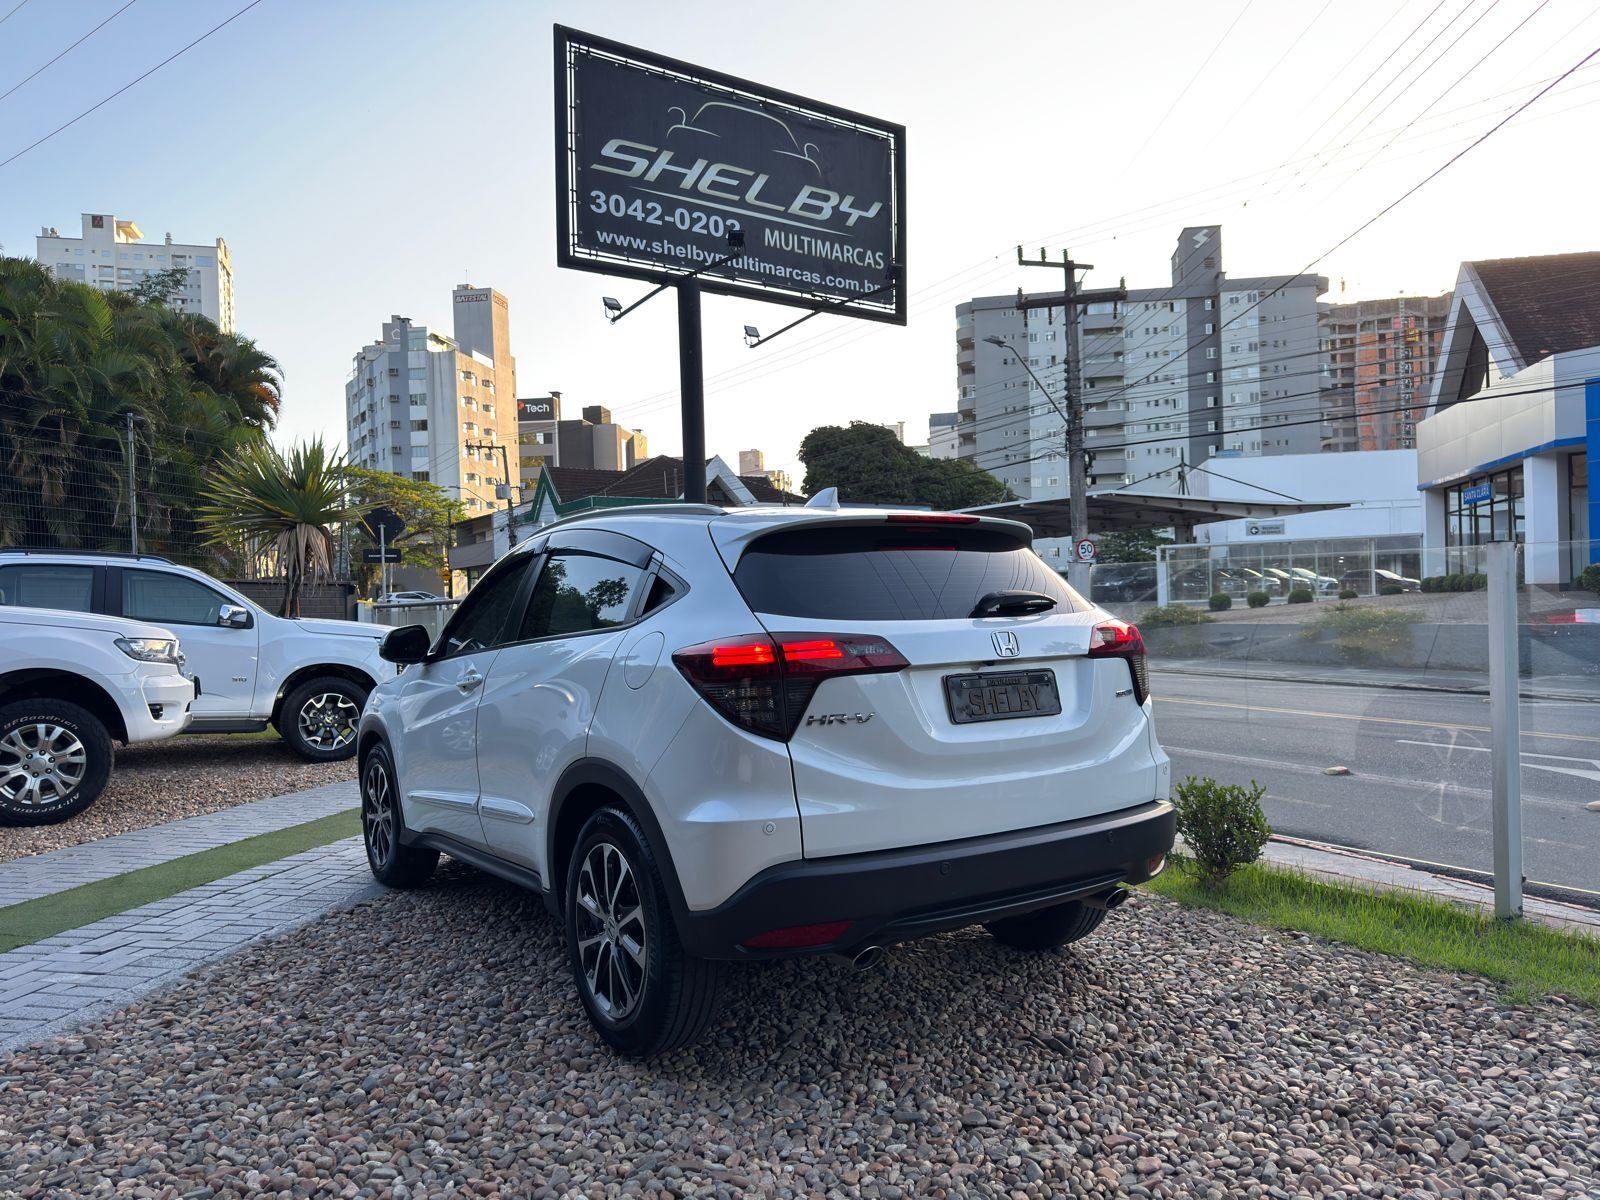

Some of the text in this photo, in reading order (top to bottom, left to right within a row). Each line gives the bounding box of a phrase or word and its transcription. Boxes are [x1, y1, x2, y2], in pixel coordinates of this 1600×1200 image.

[590, 138, 883, 227] SHELBY
[764, 227, 885, 269] MULTIMARCAS
[525, 403, 550, 413] Tech
[1080, 543, 1093, 554] 50
[968, 684, 1041, 716] SHELBY
[806, 711, 875, 727] HR-V
